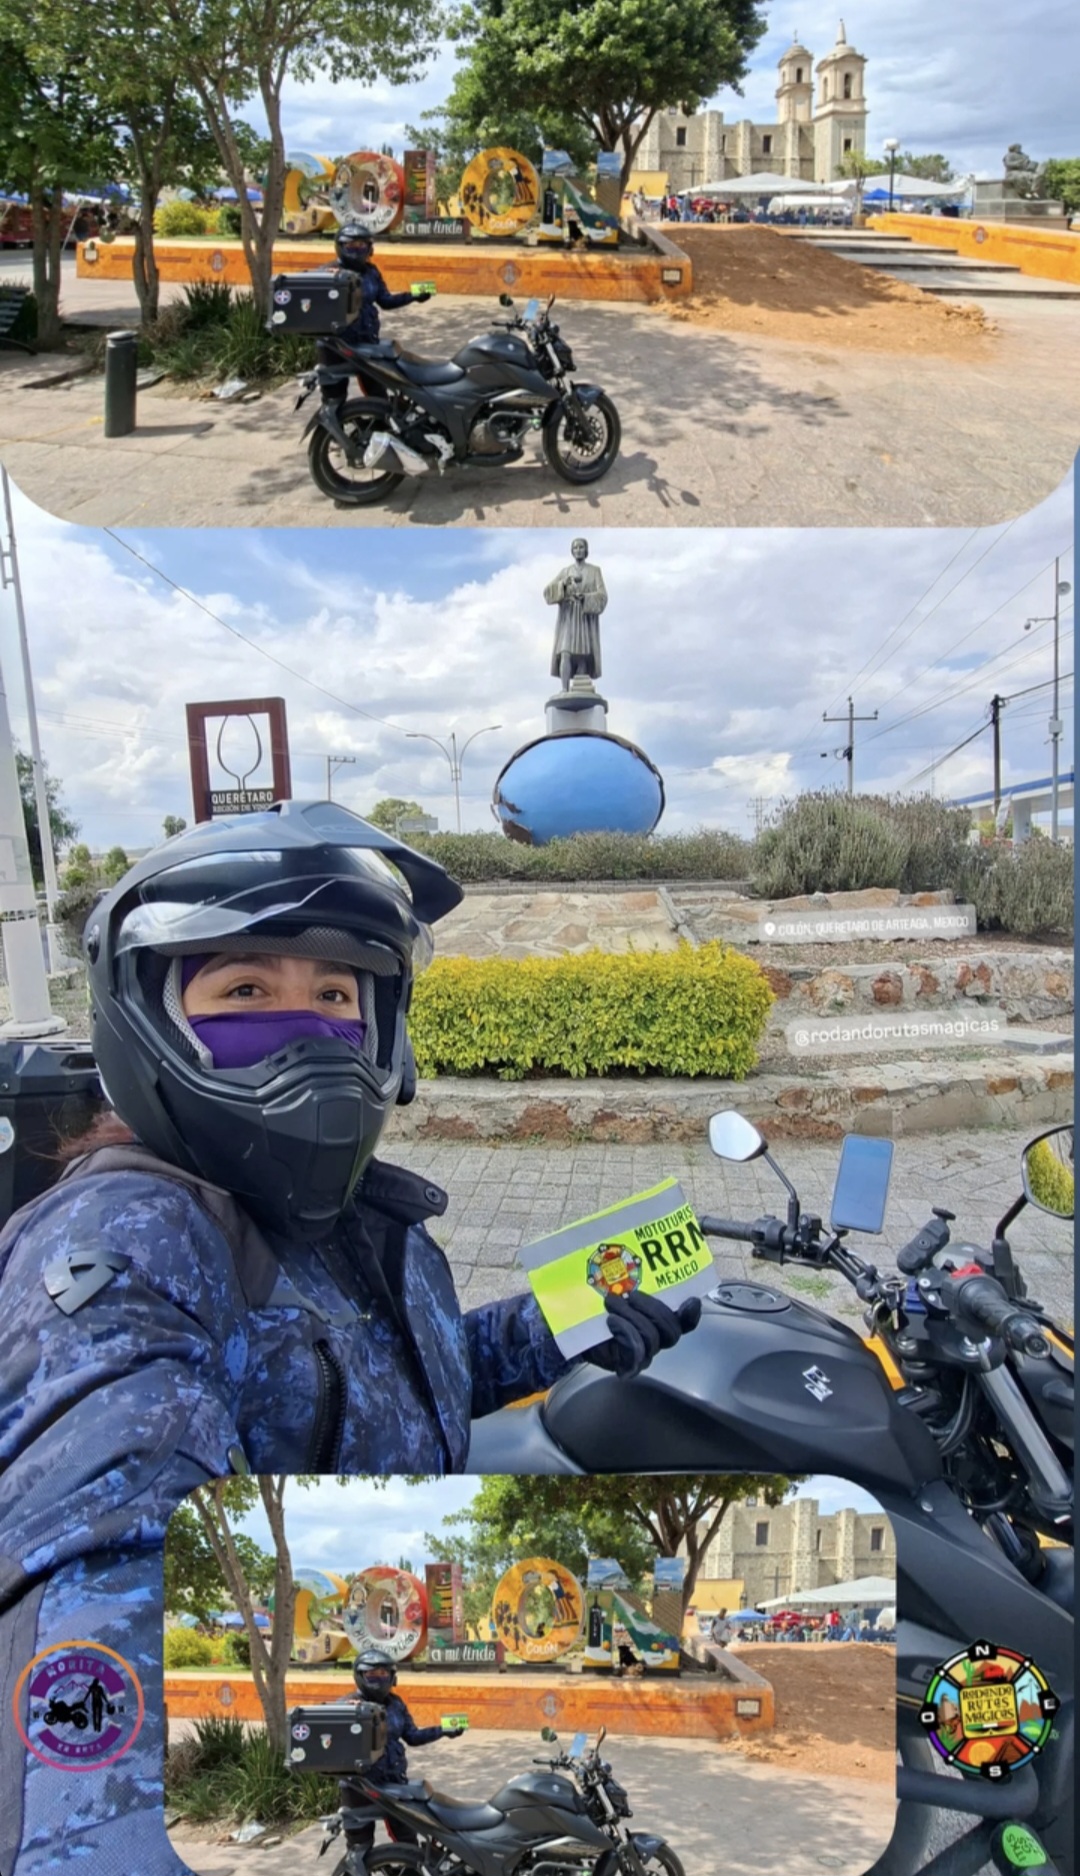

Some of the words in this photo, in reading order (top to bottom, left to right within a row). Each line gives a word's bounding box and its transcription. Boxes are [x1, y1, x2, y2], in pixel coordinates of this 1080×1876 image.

[211, 790, 274, 804] QUERÉTARO
[241, 803, 251, 812] DE
[634, 1205, 694, 1242] MOTOTURIS
[431, 1650, 442, 1662] a
[445, 1649, 460, 1662] mi
